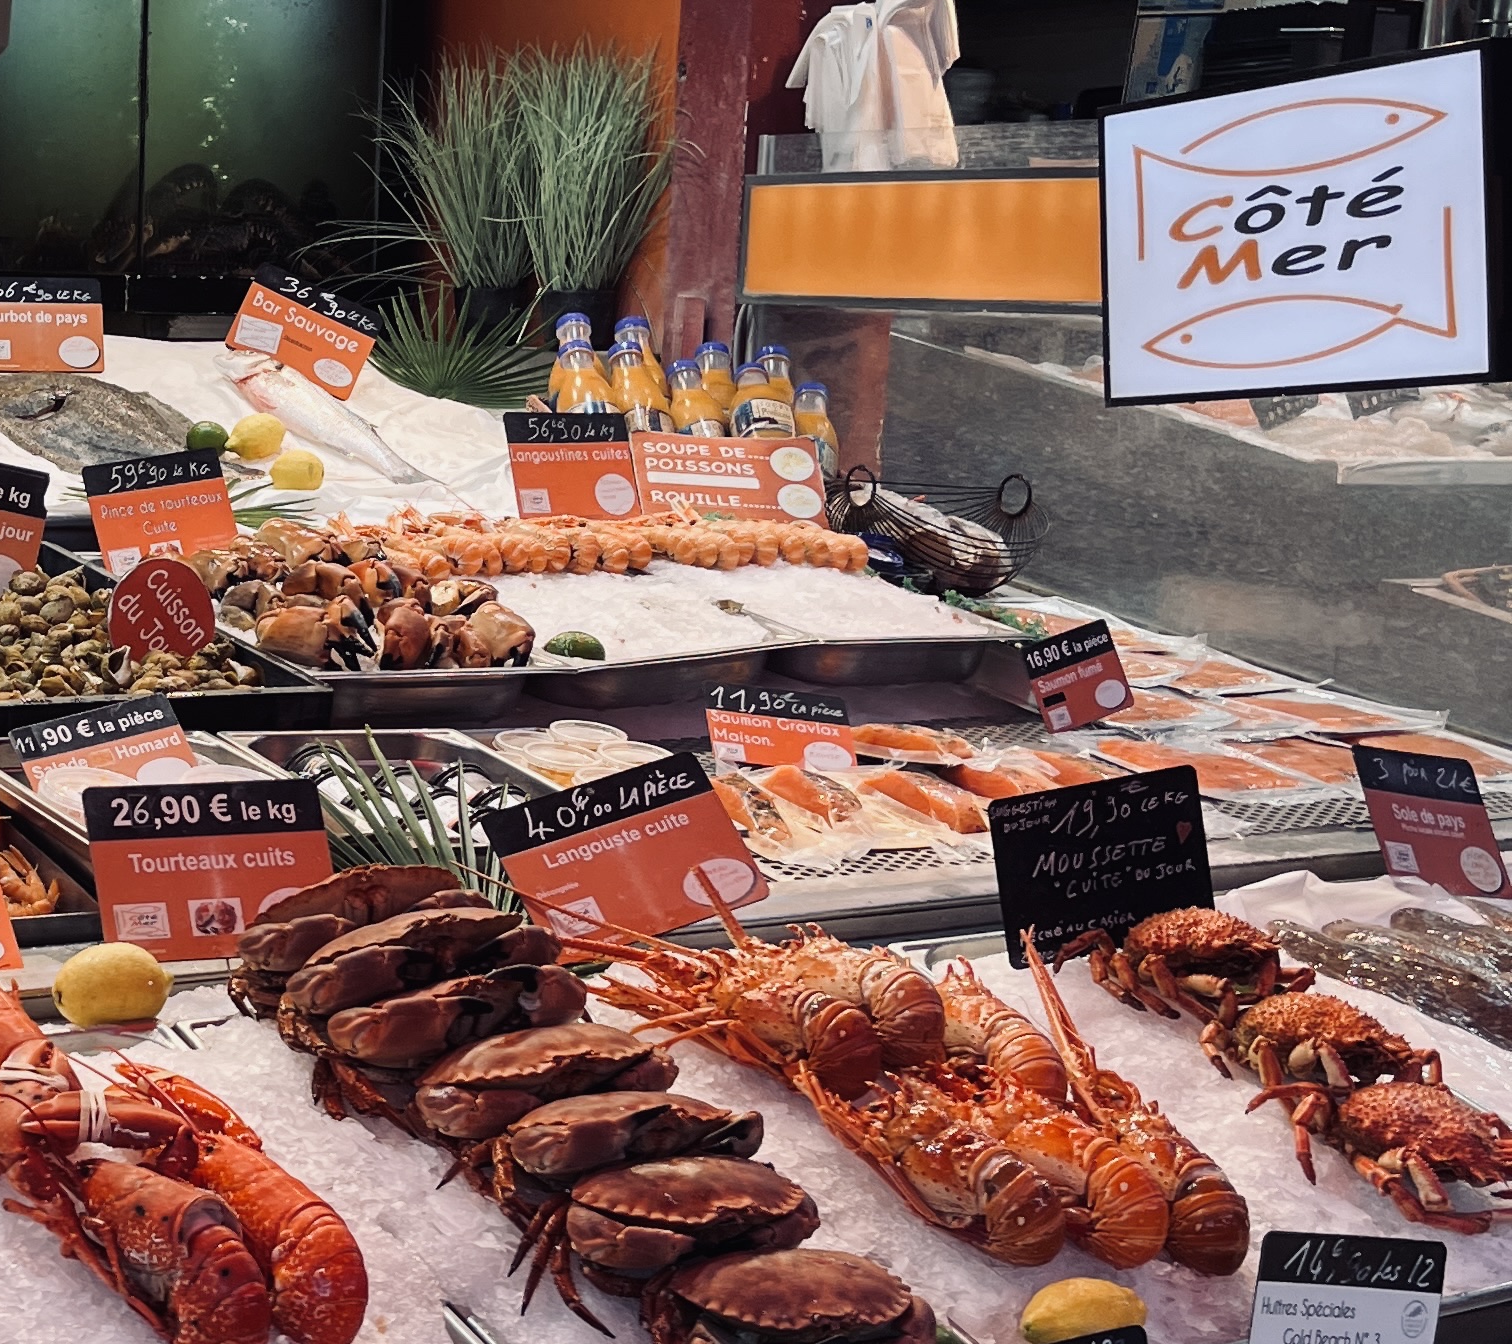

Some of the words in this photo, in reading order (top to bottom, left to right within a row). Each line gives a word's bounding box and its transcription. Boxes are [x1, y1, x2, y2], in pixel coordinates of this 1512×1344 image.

[1168, 165, 1405, 242] Côté
[1176, 234, 1392, 289] Mer
[35, 310, 53, 324] de
[56, 312, 88, 326] pays
[252, 290, 280, 316] Bar
[283, 306, 359, 354] Sauvage
[510, 447, 588, 464] Langoustines
[592, 449, 629, 461] cuites
[643, 442, 710, 456] SOUPE
[645, 458, 755, 475] POISSONS
[8, 485, 31, 509] kg
[100, 502, 135, 521] Pince
[139, 500, 155, 514] de
[0, 521, 35, 544] jour
[142, 520, 178, 537] Cuite
[118, 594, 144, 624] du
[148, 569, 205, 647] Cuisson
[1026, 644, 1060, 669] 16,90
[1083, 633, 1108, 652] pièce
[1037, 671, 1078, 694] Saumon
[14, 724, 72, 754] 11,90
[97, 719, 116, 734] la
[122, 707, 164, 730] pièce
[709, 709, 772, 730] Saumon
[776, 717, 841, 739] Gravlax
[114, 731, 182, 761] Homard
[110, 794, 200, 830] 26,90
[209, 793, 232, 822] €
[240, 800, 262, 822] le
[269, 799, 297, 824] kg
[1391, 803, 1419, 822] Sole
[1420, 808, 1435, 825] de
[1438, 814, 1466, 831] pays
[541, 827, 642, 871] Langouste
[644, 811, 690, 836] cuite
[127, 850, 240, 876] Tourteaux
[241, 847, 296, 868] cuits
[1032, 837, 1167, 879] MOUSSETTE
[1301, 1298, 1356, 1321] Spéciales
